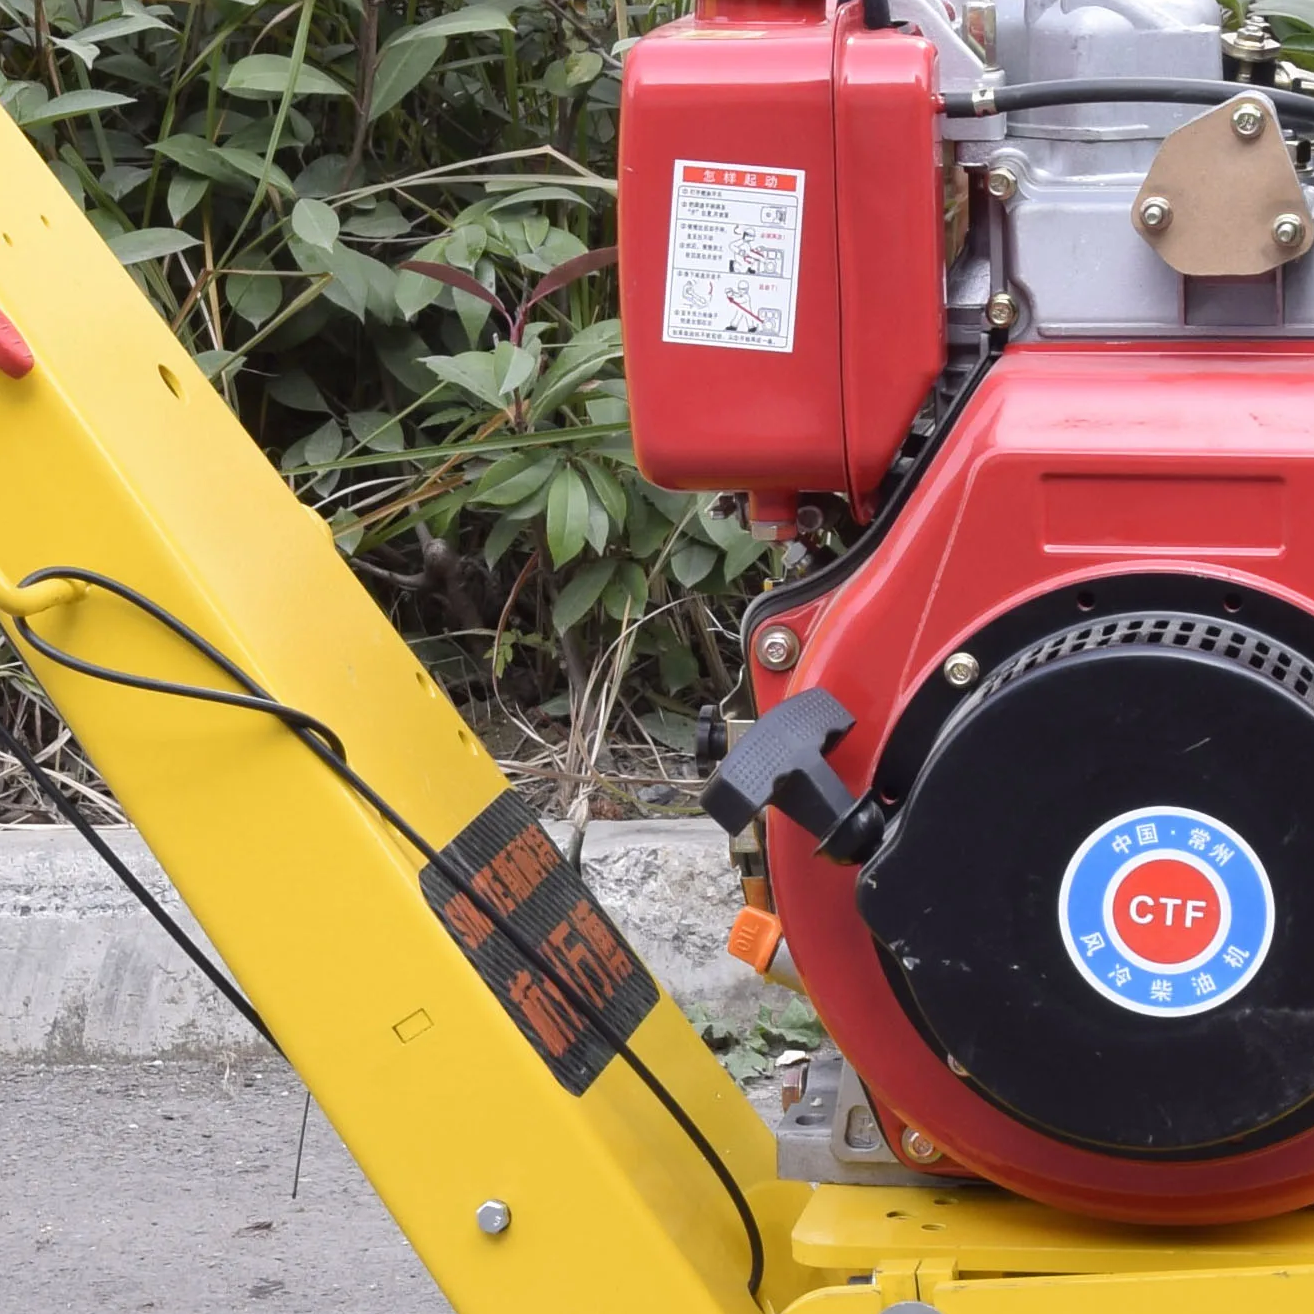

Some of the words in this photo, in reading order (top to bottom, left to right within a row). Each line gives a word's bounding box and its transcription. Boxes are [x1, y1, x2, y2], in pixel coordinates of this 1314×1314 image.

[702, 170, 779, 188] 怎样起动
[1128, 894, 1208, 928] CTF
[734, 924, 760, 953] OIL
[1078, 931, 1252, 1003] 风冷柴油机
